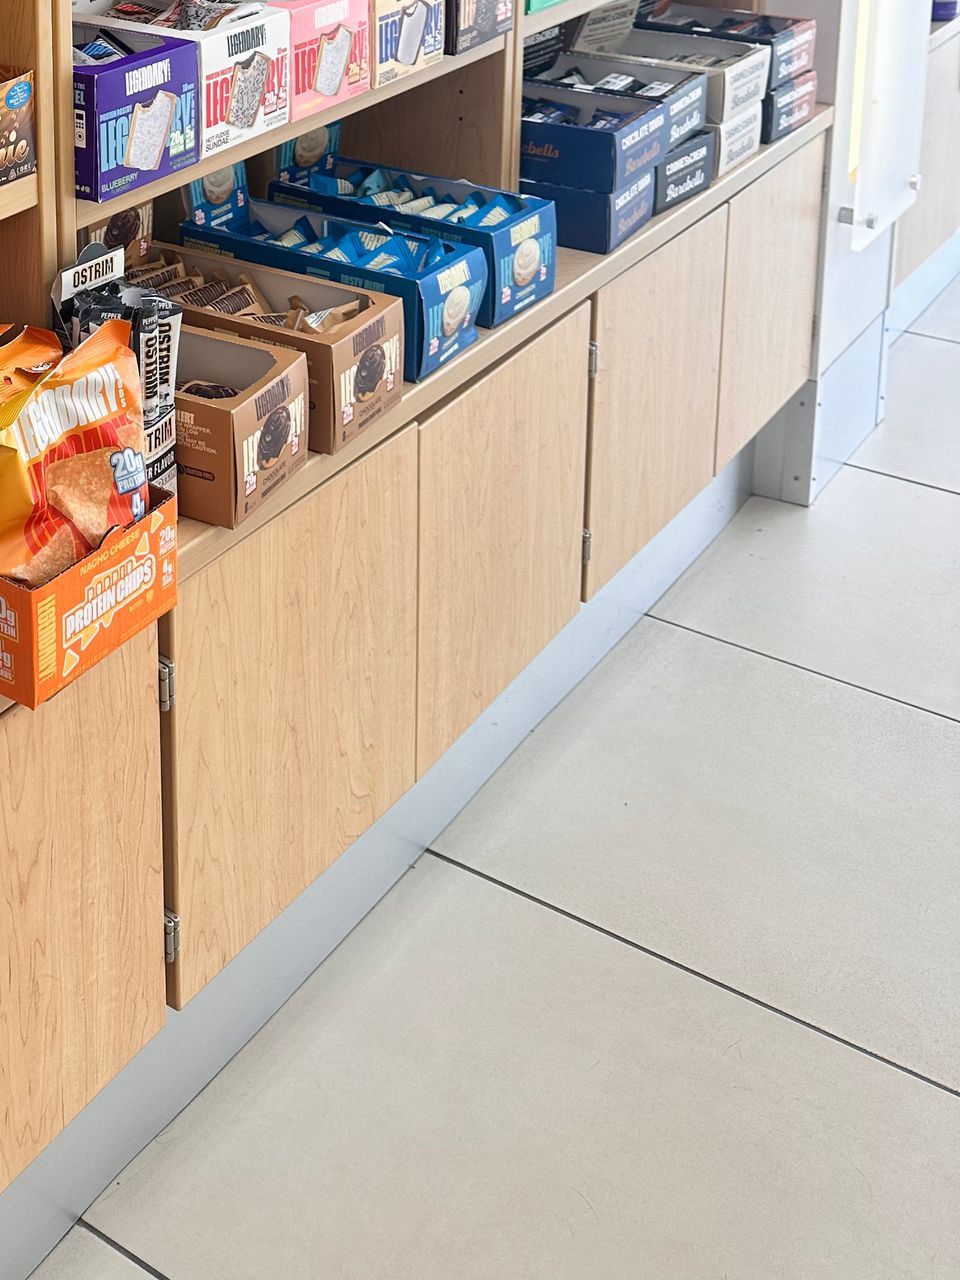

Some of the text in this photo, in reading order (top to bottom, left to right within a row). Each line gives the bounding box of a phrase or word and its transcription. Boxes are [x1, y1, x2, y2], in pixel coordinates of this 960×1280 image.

[227, 25, 264, 58] LEGENDARY
[125, 59, 170, 96] LEGENDARY
[669, 110, 701, 142] Barebells
[205, 136, 229, 152] SUNDAE
[101, 172, 138, 192] BLUEBERRY
[665, 171, 705, 202] Barebells
[72, 256, 114, 288] OSTRIM
[185, 424, 211, 434] WRAPPER.
[192, 443, 217, 455] CAUTION.
[66, 559, 152, 640] PROTEIN CHIPS
